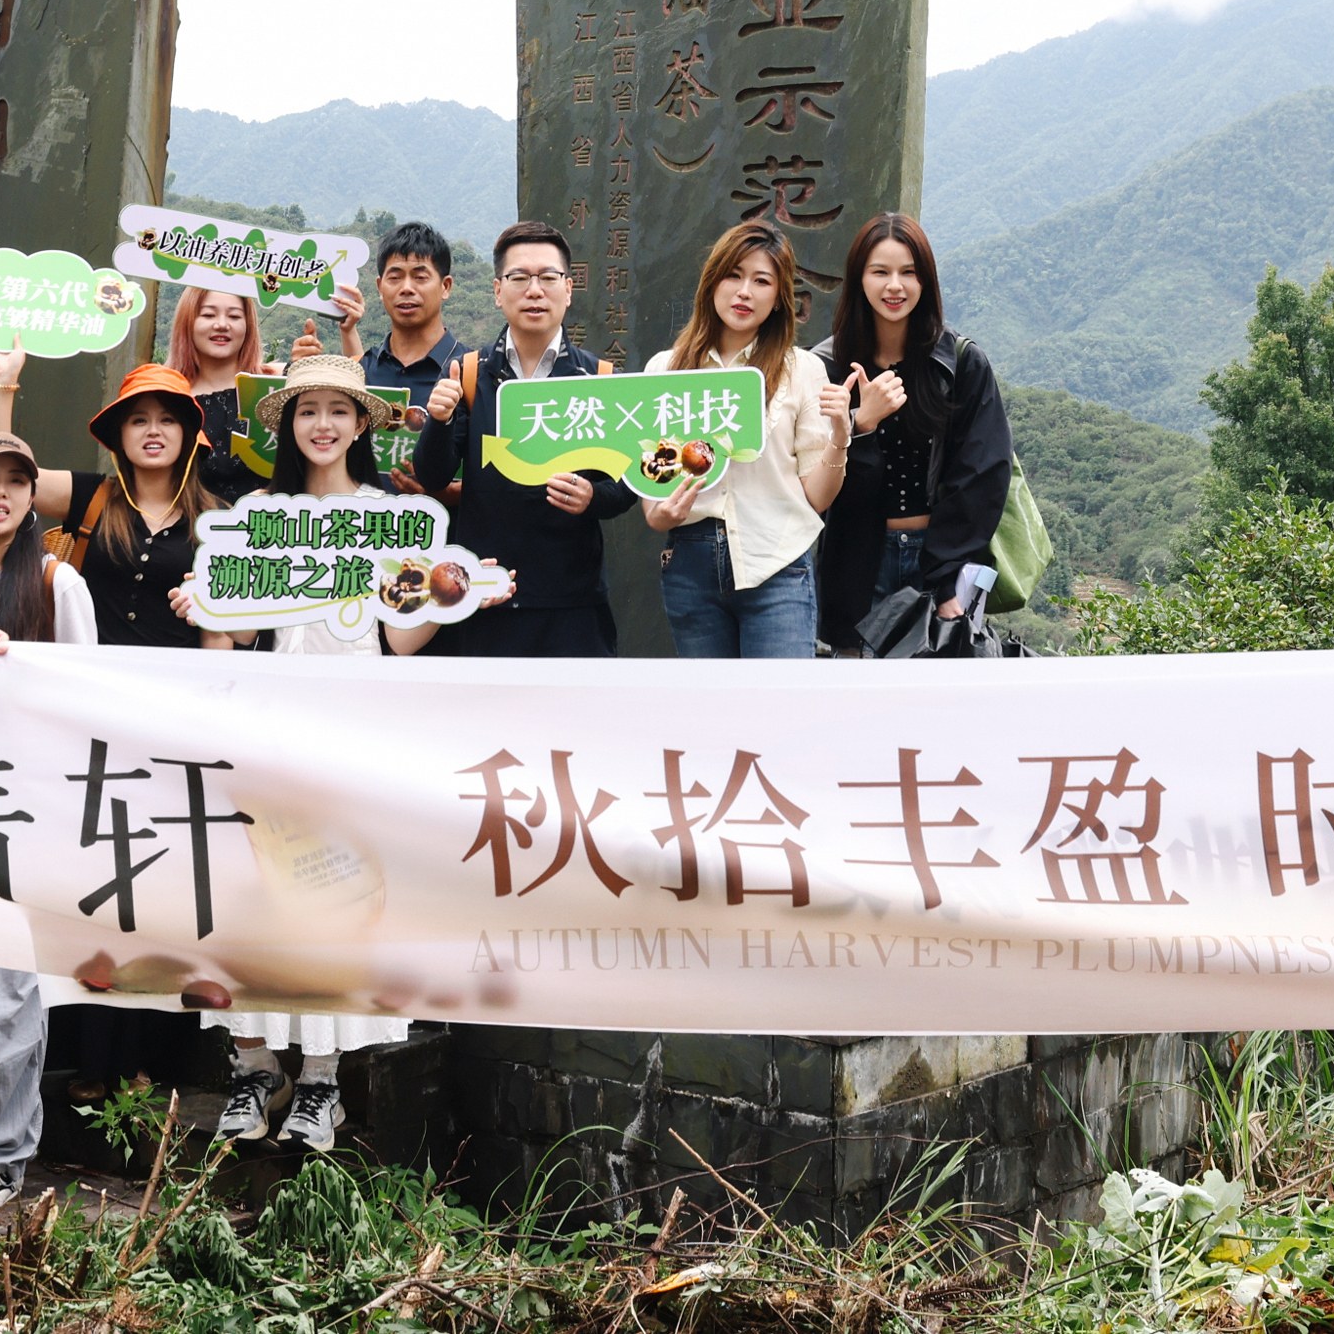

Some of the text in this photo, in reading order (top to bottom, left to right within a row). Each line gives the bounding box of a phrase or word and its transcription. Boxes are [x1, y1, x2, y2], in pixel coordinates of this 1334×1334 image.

[604, 9, 637, 371] 江西省人力资源和社会
[158, 230, 327, 285] 以油养肤开创者
[518, 388, 744, 444] 天然×科技
[210, 508, 436, 550] 一颗山茶果的
[208, 554, 376, 600] 溯源之旅
[453, 747, 1190, 911] 秋拾丰盈
[468, 926, 713, 974] AUTUMN
[737, 927, 1011, 971] HARVEST
